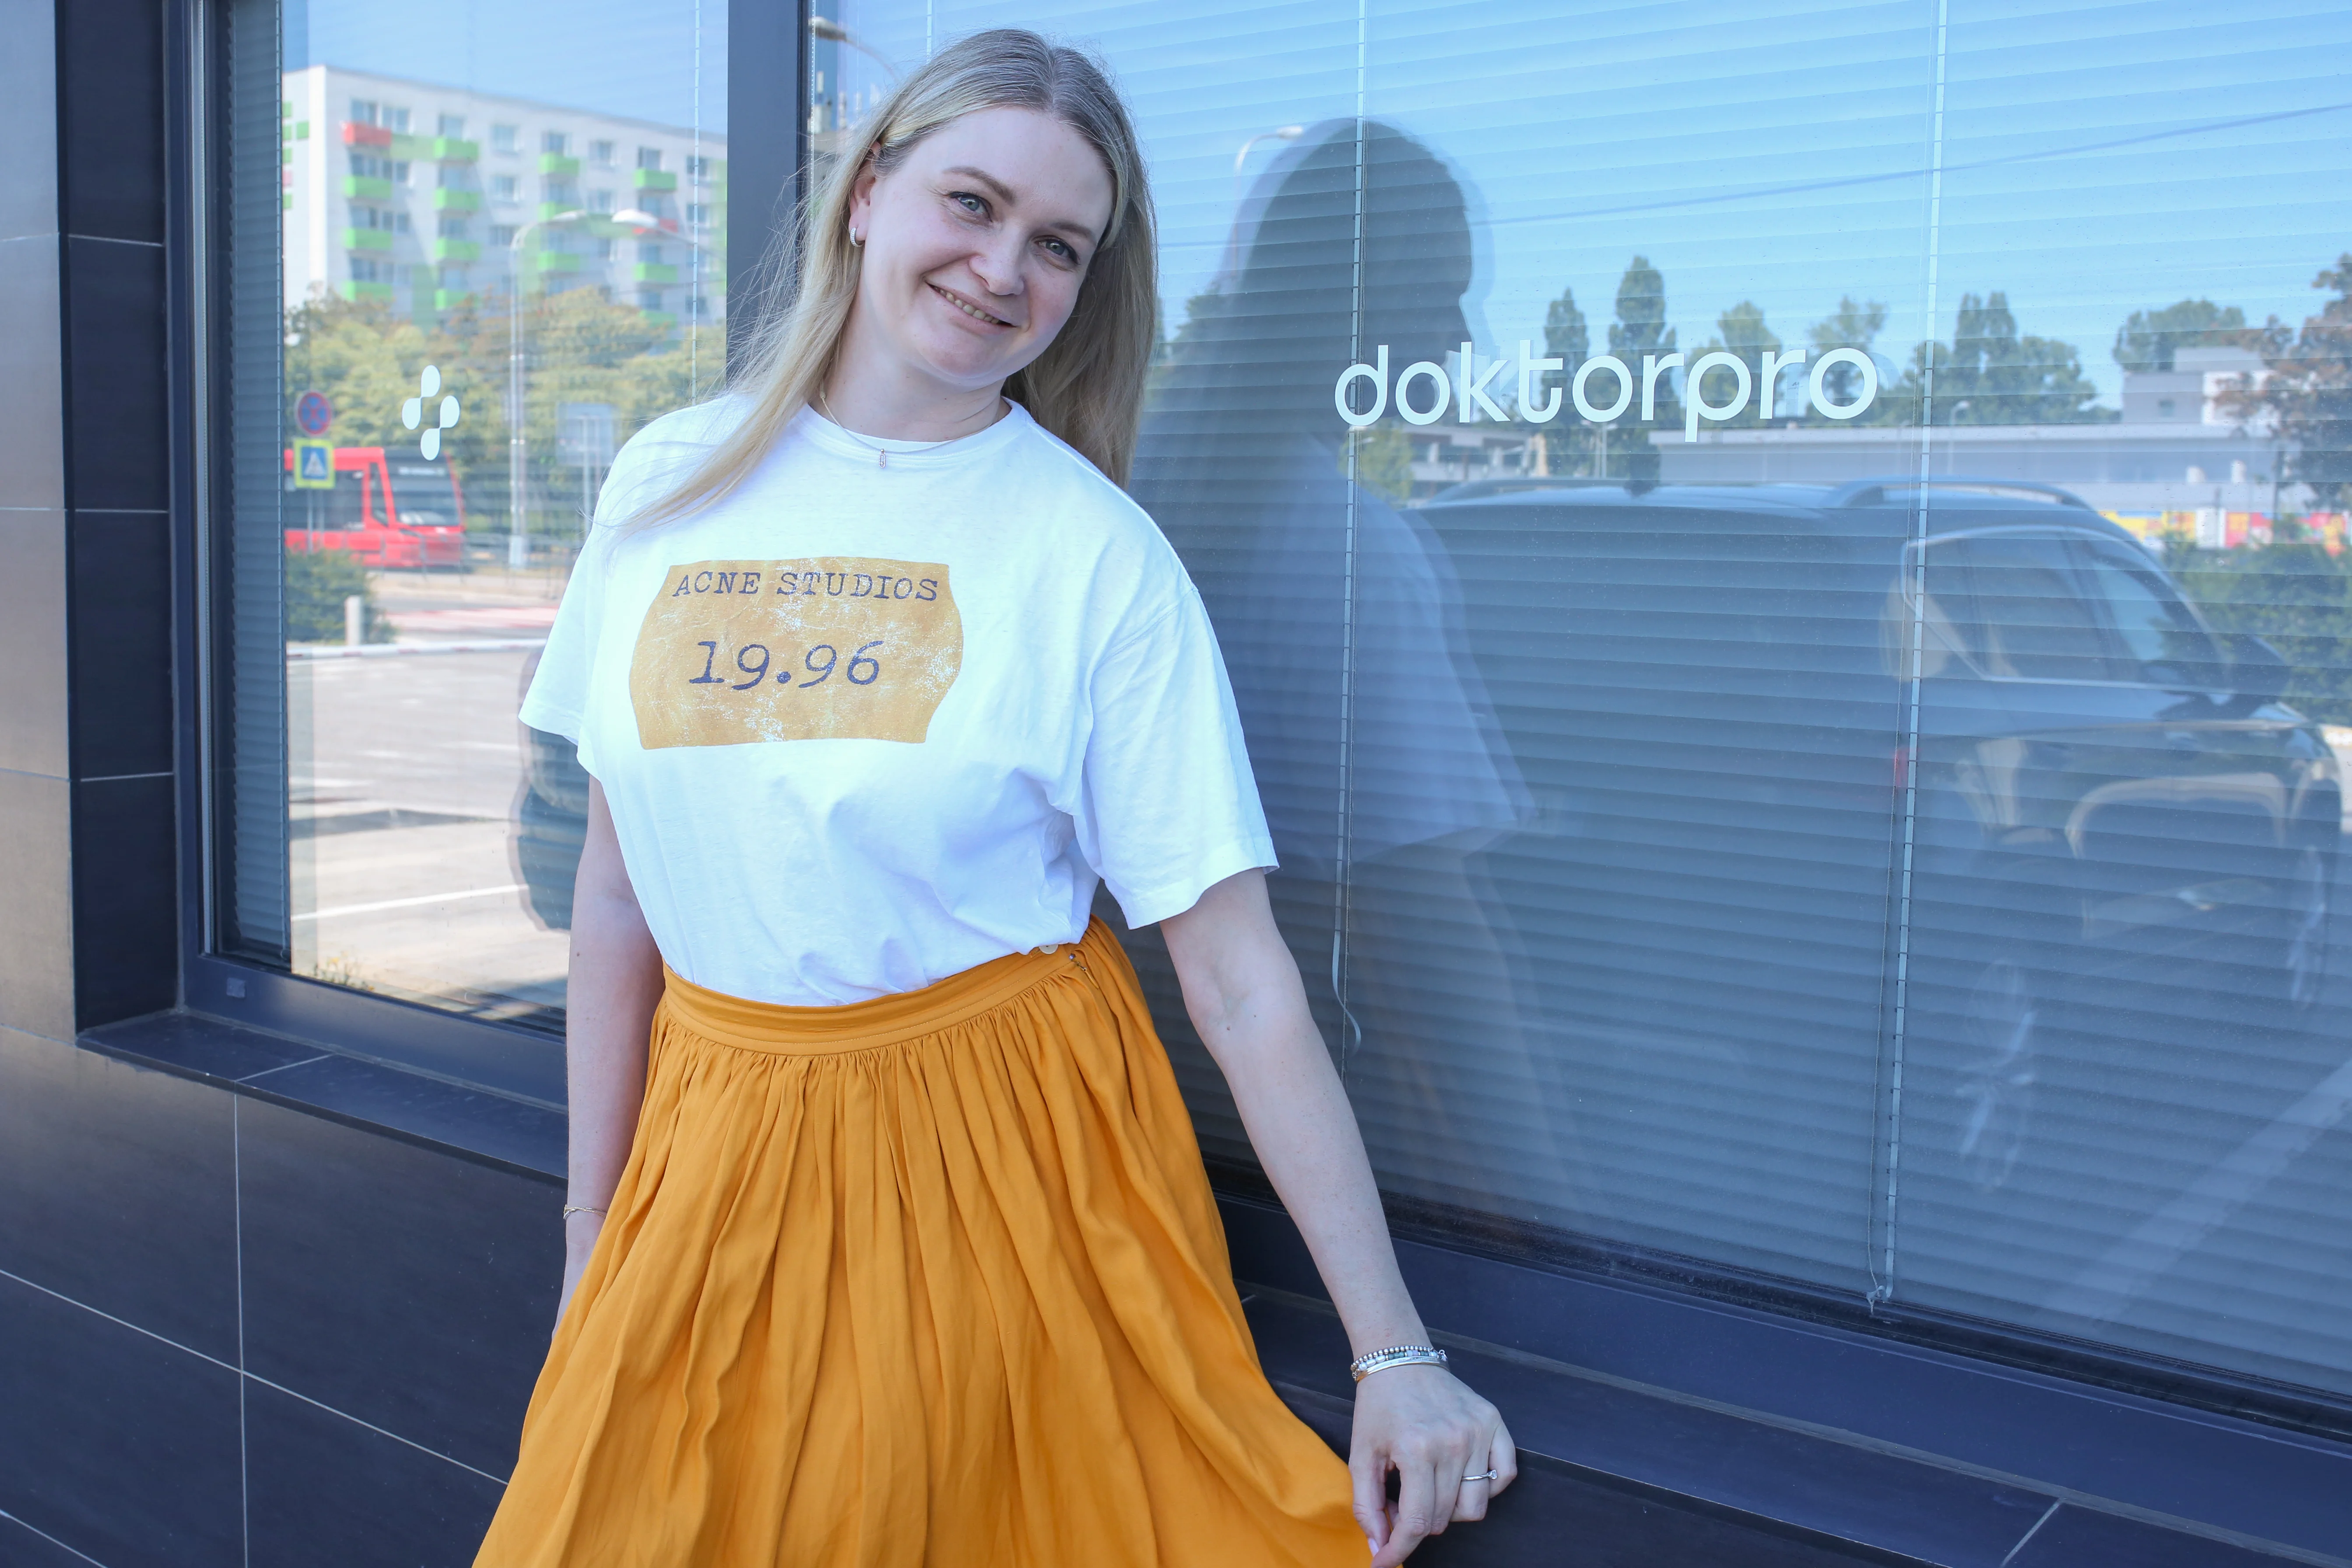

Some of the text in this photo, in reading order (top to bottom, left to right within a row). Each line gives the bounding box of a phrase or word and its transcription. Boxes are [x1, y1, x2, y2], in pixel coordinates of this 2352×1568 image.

[1334, 339, 1878, 443] doktorpro
[672, 571, 938, 601] ACNE STUDIOS
[688, 641, 884, 691] 19.96
